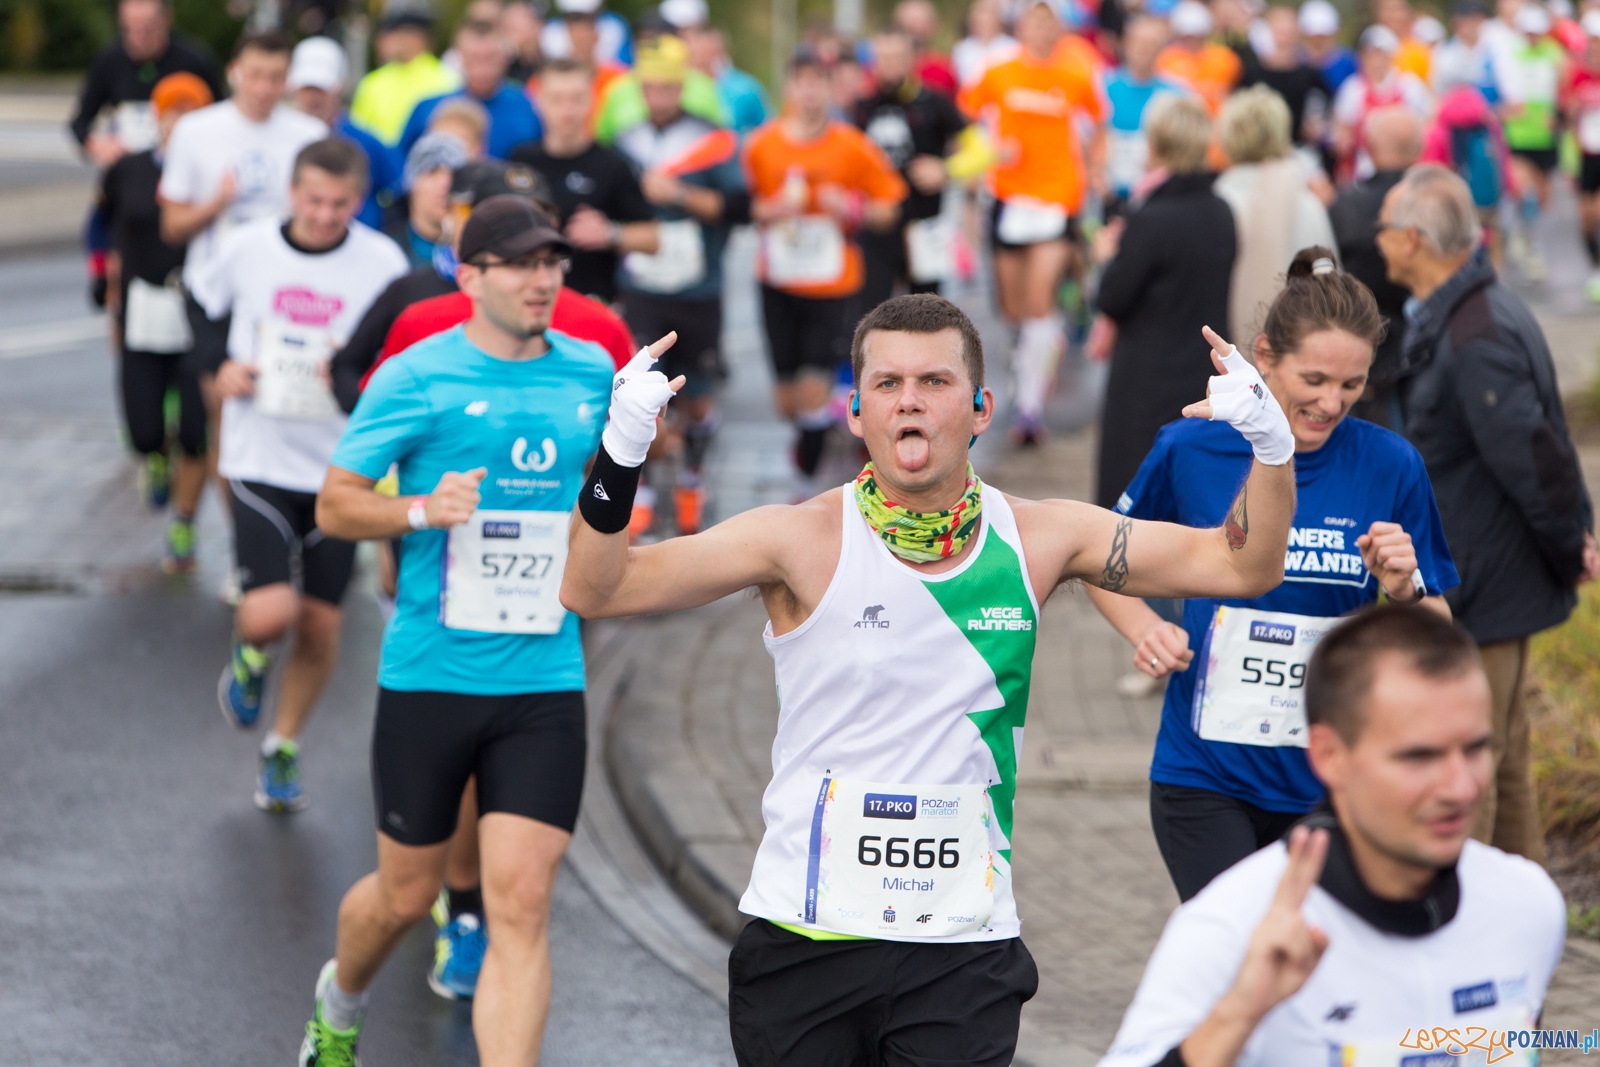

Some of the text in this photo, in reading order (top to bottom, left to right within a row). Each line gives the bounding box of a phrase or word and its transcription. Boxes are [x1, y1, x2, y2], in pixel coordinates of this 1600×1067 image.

[1288, 527, 1345, 550] NER'S
[482, 553, 552, 578] 5727
[1284, 550, 1363, 575] WANIE
[980, 607, 1022, 619] VEGE
[853, 620, 890, 629] ATTIQ
[967, 619, 1033, 631] RUNNERS
[1254, 625, 1293, 640] 17. PKO
[1241, 657, 1307, 688] 559
[1271, 695, 1299, 708] Ewa
[868, 800, 913, 813] 17. PKO
[921, 807, 958, 816] maraton
[858, 835, 960, 869] 6666
[883, 876, 936, 891] Michał
[916, 914, 933, 923] 4F
